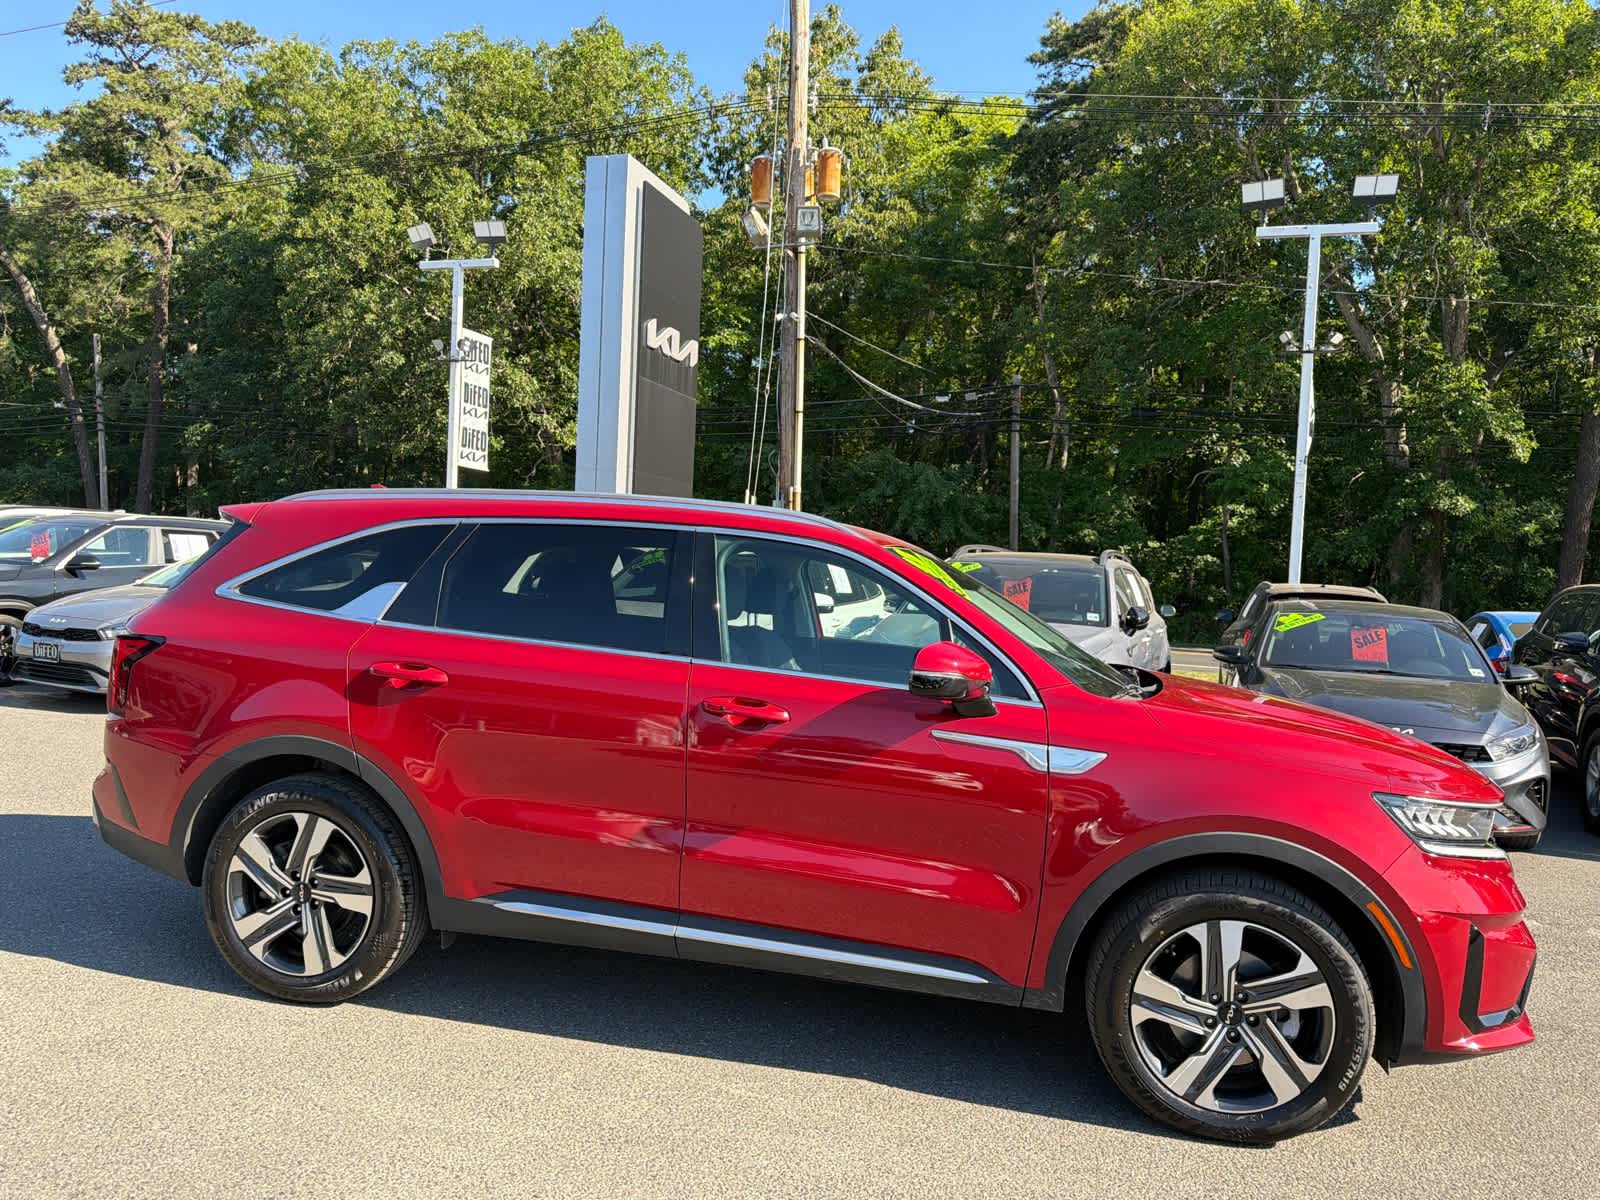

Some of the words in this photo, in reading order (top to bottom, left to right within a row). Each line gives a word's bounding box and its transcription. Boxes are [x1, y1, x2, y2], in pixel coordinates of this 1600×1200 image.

[646, 318, 699, 367] KIA
[1007, 581, 1029, 596] SALE
[1354, 631, 1383, 648] SALE
